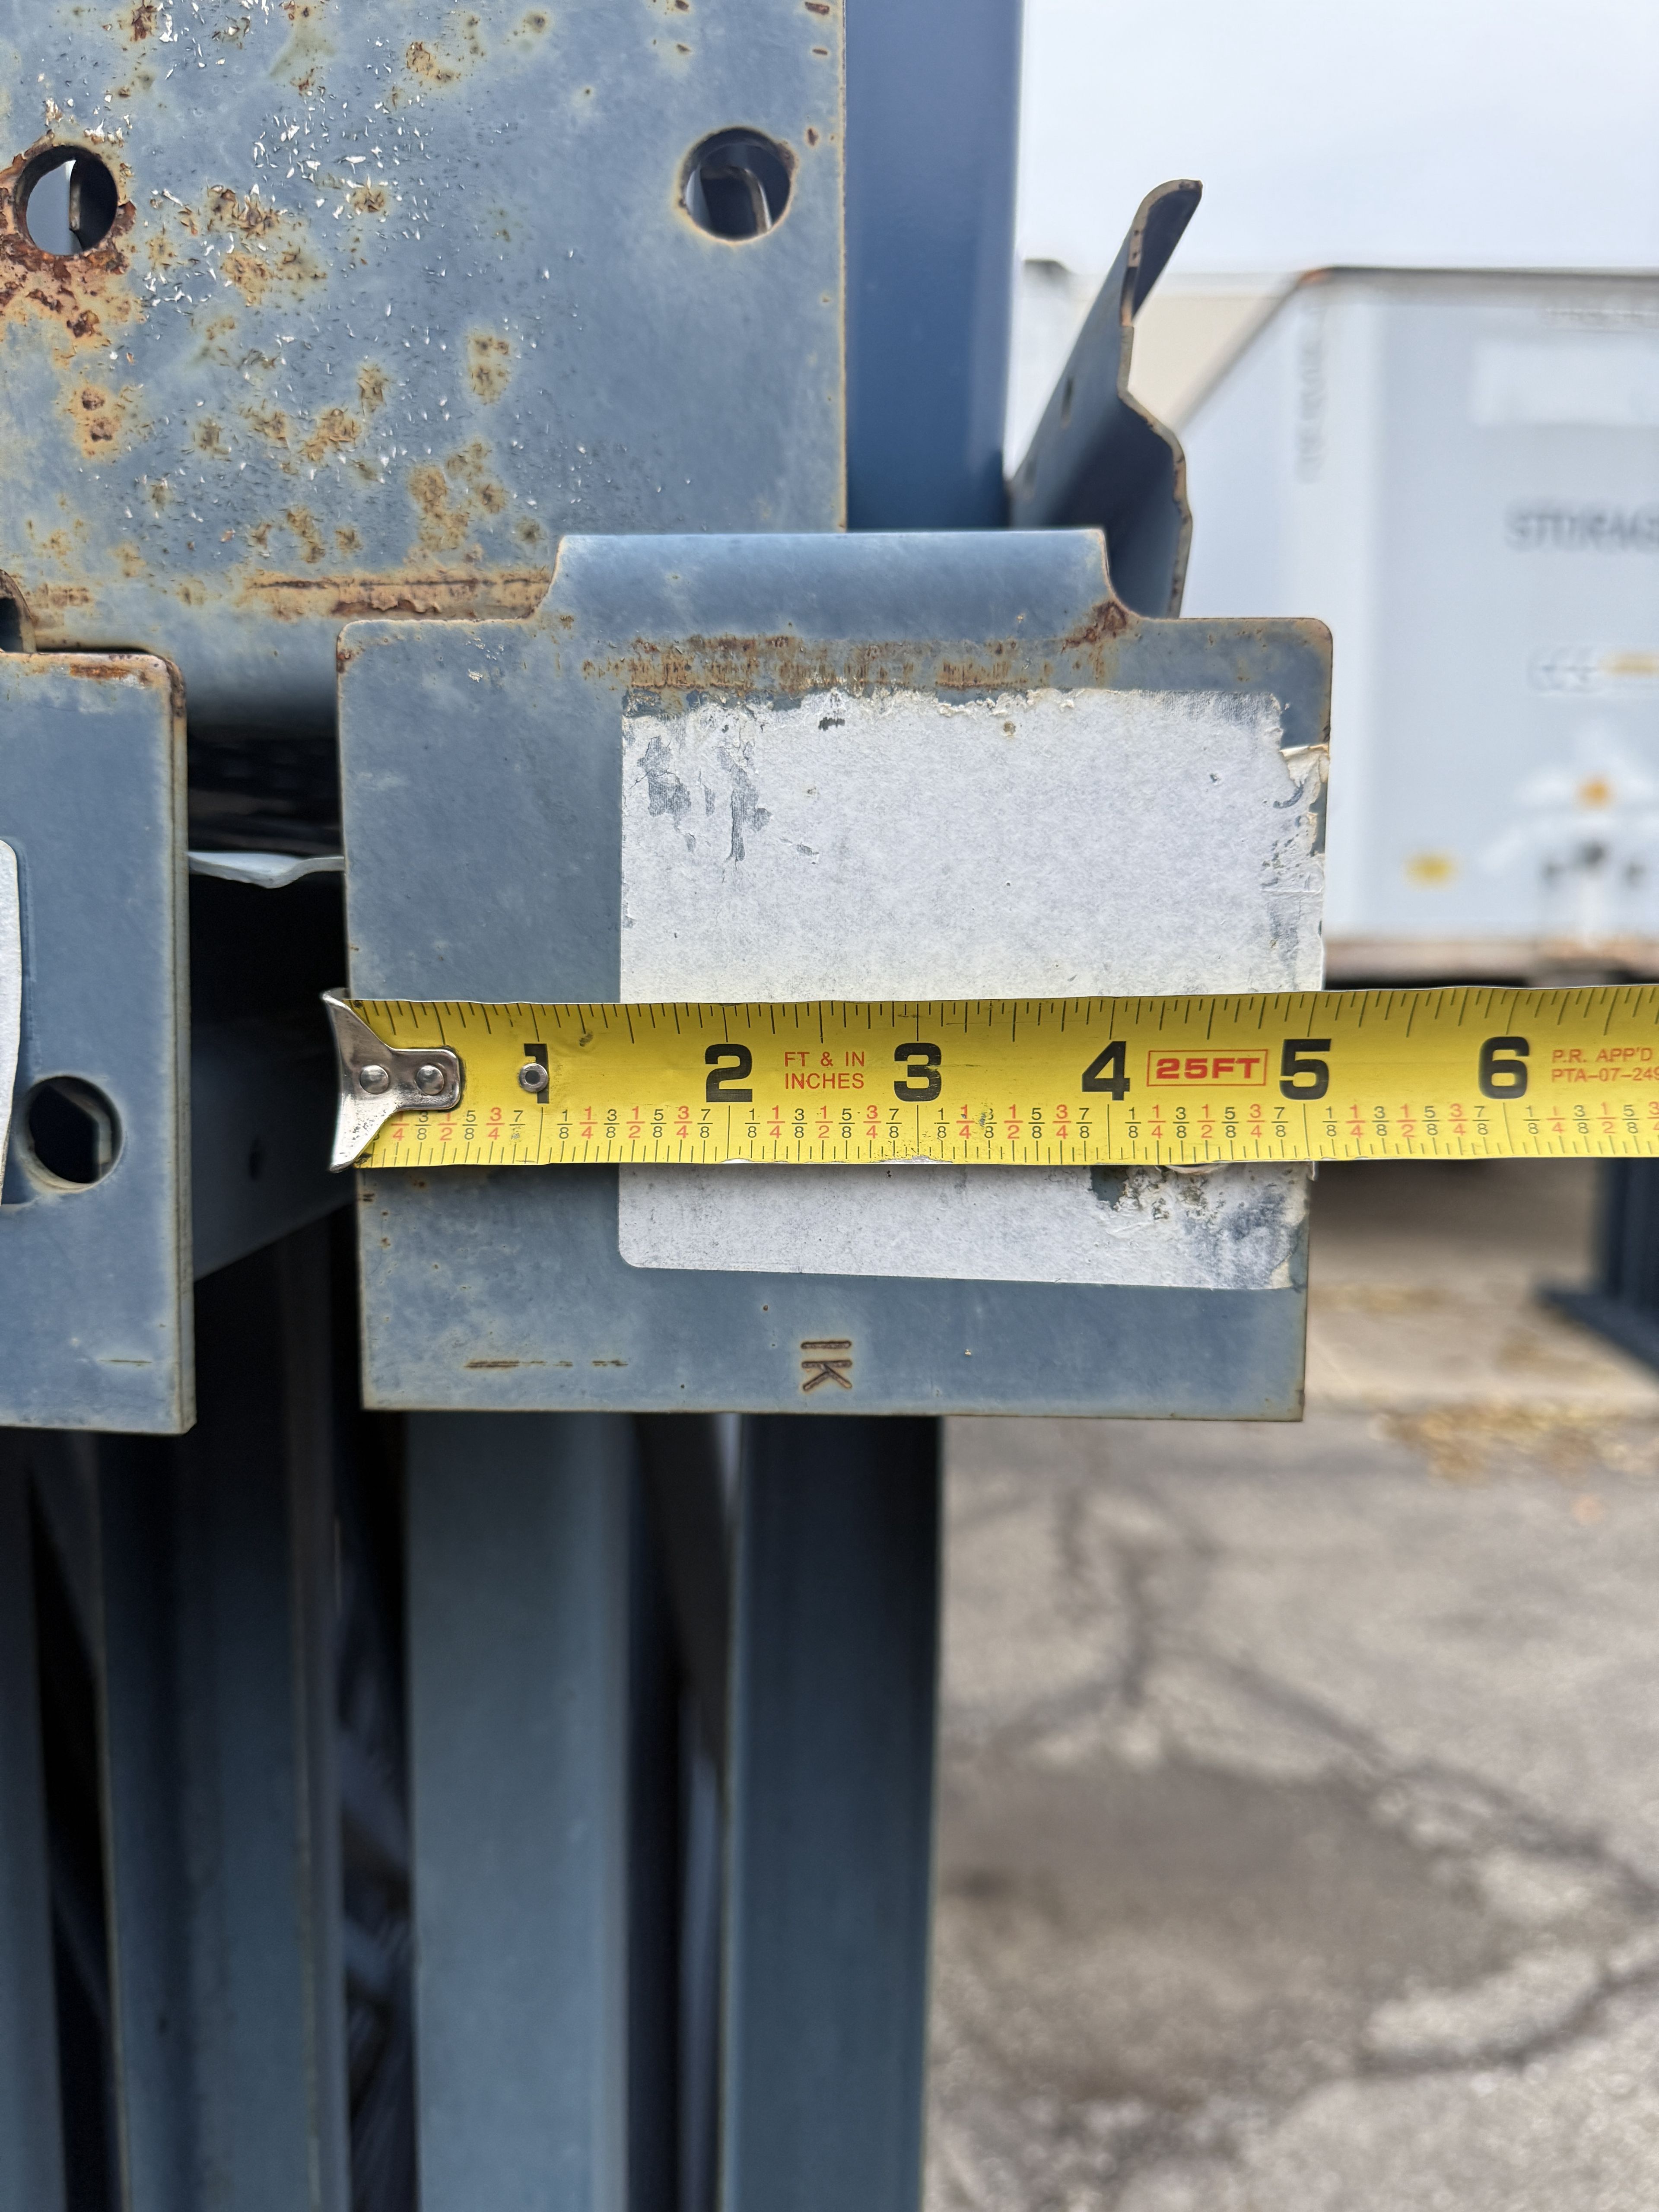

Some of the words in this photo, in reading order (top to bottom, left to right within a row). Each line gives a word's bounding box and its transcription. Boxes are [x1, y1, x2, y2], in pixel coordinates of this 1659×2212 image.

[524, 1043, 550, 1103] 1
[705, 1043, 753, 1103] 2
[784, 1051, 810, 1067] FT
[820, 1051, 834, 1067] &
[845, 1051, 864, 1067] IN
[785, 1072, 864, 1090] INCHES
[893, 1042, 942, 1102] 3
[1081, 1040, 1131, 1101] 4
[1156, 1057, 1260, 1080] 25FT
[1279, 1038, 1332, 1100] 5
[1478, 1036, 1530, 1100] 6
[1595, 1047, 1653, 1062] APP'D
